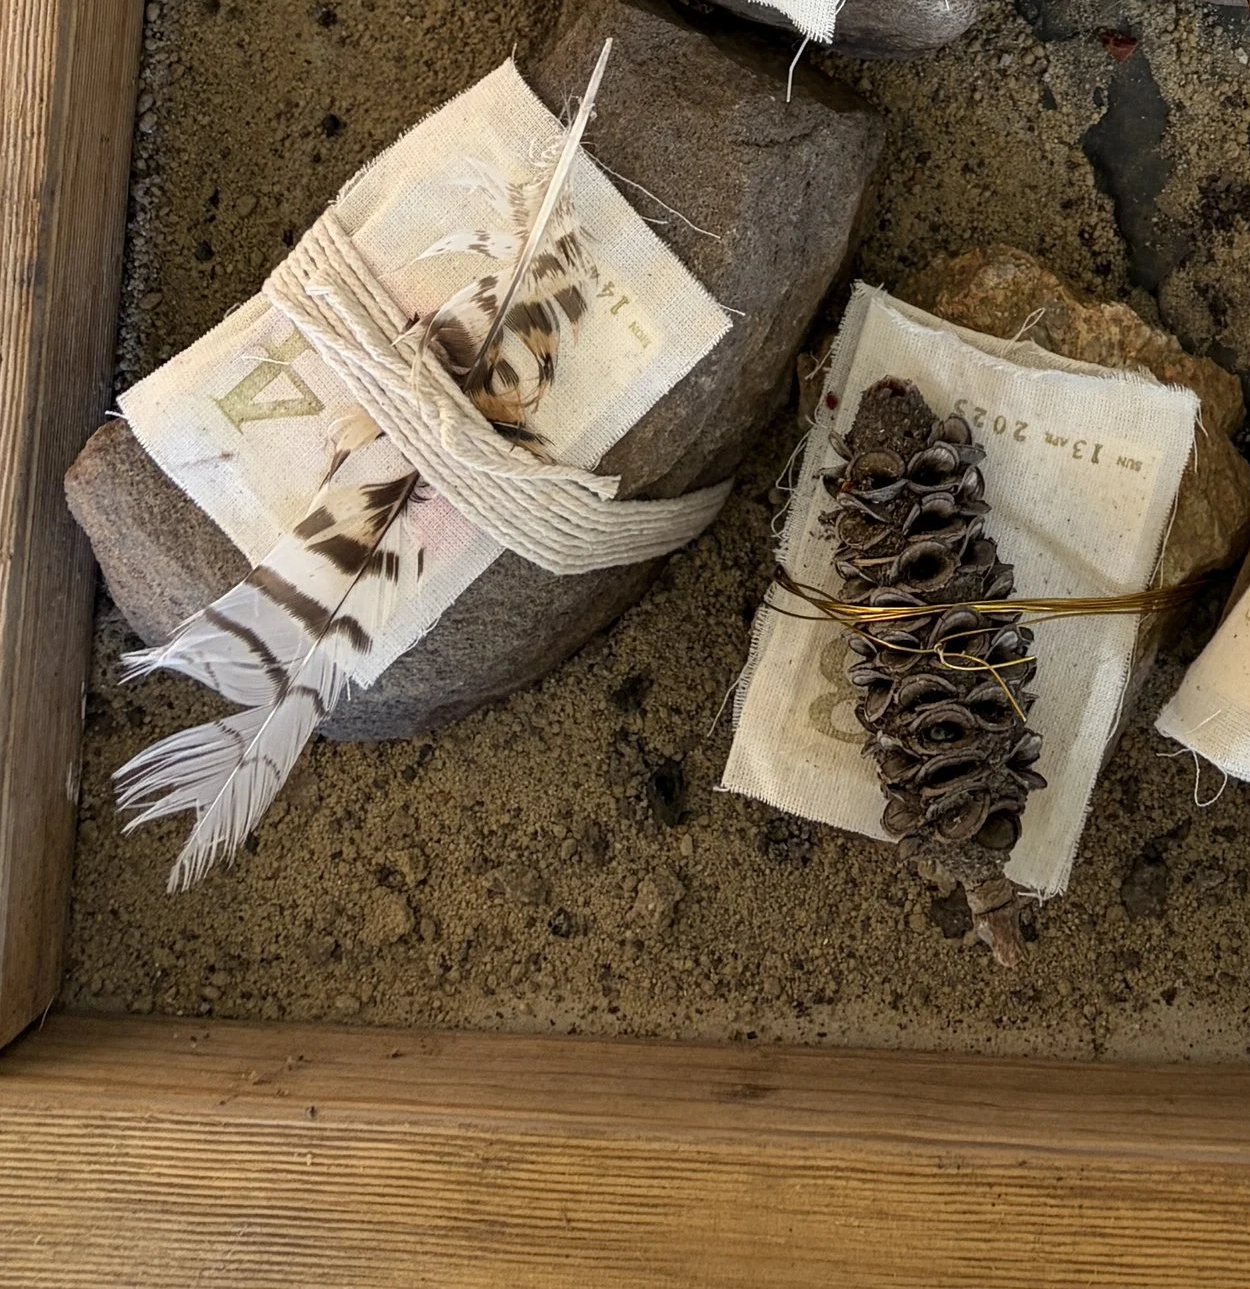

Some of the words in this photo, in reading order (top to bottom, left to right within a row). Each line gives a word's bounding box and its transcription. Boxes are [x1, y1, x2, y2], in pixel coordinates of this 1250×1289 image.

[596, 281, 629, 316] 14
[210, 324, 326, 435] 4
[954, 399, 1029, 443] 2025
[1045, 432, 1069, 448] APR
[1072, 440, 1104, 465] 13
[1116, 455, 1144, 473] SUN
